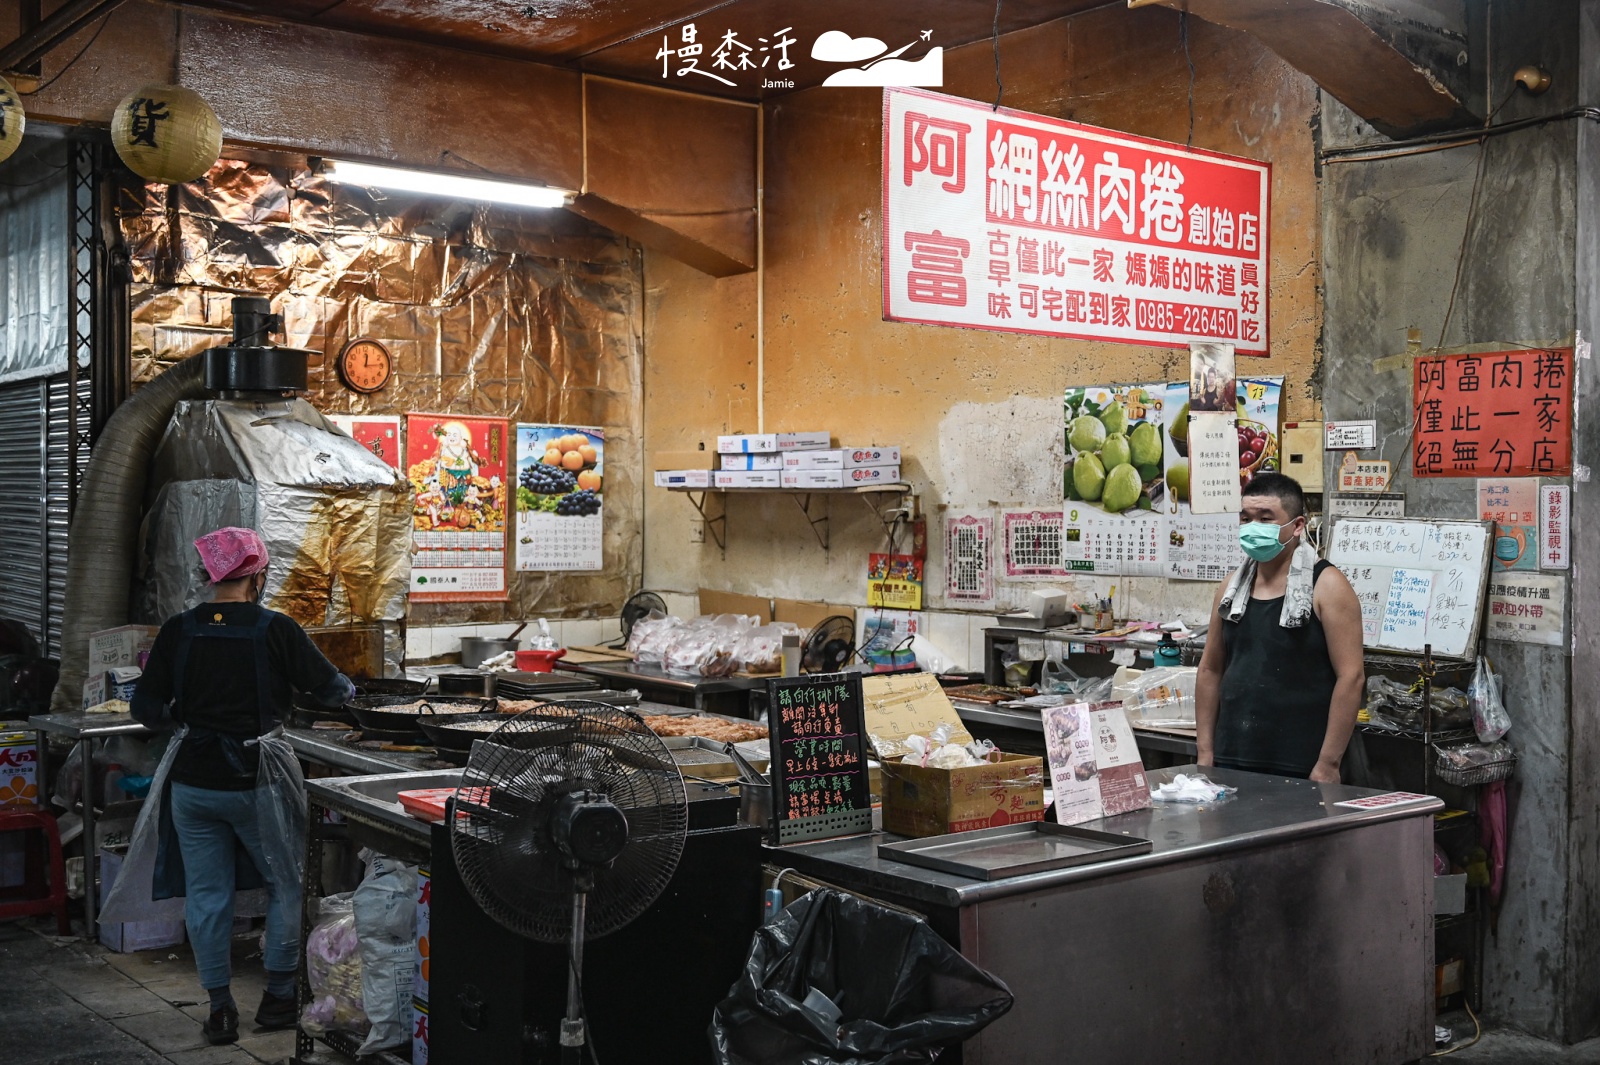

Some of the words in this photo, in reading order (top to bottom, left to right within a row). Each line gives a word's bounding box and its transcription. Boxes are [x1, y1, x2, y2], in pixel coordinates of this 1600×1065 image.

[130, 97, 170, 148] 貨
[987, 129, 1185, 243] 網絲肉捲
[1188, 203, 1259, 252] 創始店
[904, 111, 971, 308] 阿富
[987, 229, 1011, 319] 古早味
[1016, 236, 1114, 283] 僅此一家
[1126, 251, 1236, 297] 媽媽的味道
[1017, 283, 1131, 328] 可宅配到家
[1139, 303, 1234, 337] 0985-226450
[1419, 352, 1565, 392] 阿富肉捲
[1416, 393, 1561, 434] 僅此一家
[1415, 436, 1558, 475] 絕無分店
[1344, 475, 1385, 486] 國產豬肉
[1357, 465, 1387, 473] 本店使用
[1487, 498, 1510, 507] 比不上
[1070, 509, 1078, 521] 9
[1482, 512, 1533, 523] 戴好口罩
[1548, 491, 1562, 564] 錄影監視中
[1436, 593, 1469, 610] 星期一
[1492, 601, 1544, 619] 歡迎外帶
[907, 619, 916, 633] 26
[1430, 613, 1467, 630] 休息一天
[778, 684, 850, 708] 請自行排隊
[791, 717, 843, 736] 請自行負責
